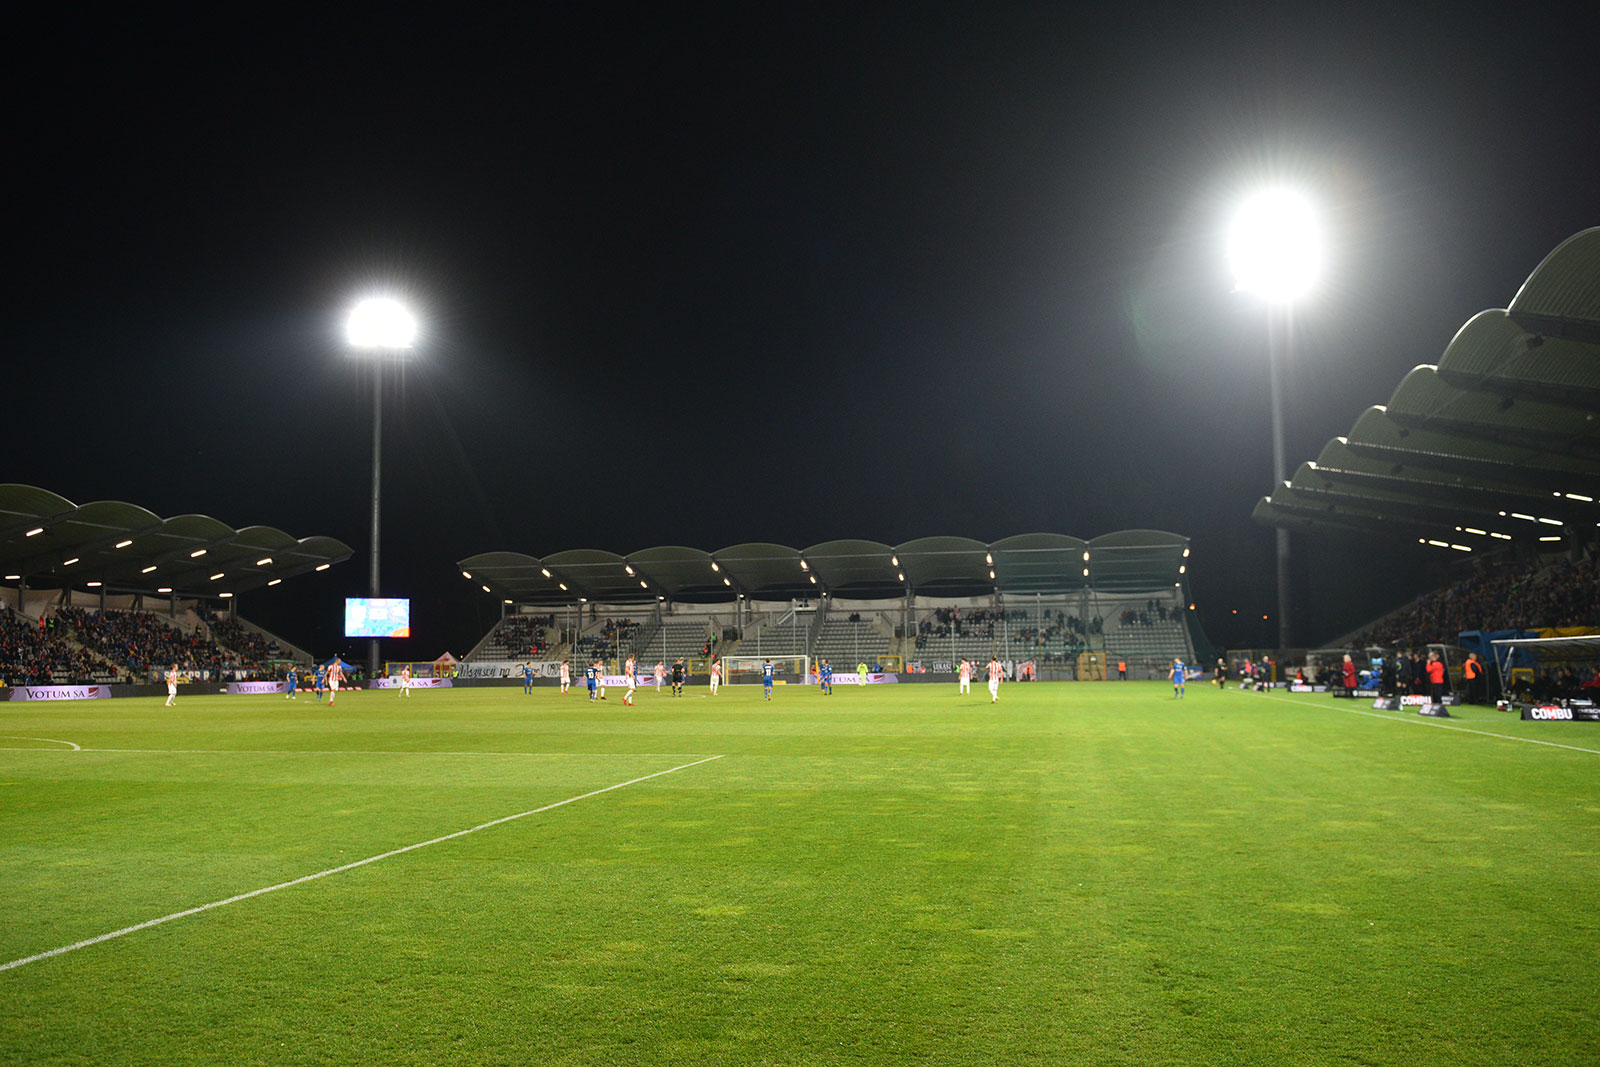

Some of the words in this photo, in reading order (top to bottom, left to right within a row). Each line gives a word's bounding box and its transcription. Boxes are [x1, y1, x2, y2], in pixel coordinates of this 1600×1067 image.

[588, 671, 594, 679] 10
[236, 683, 265, 693] VOTUM
[26, 688, 70, 699] VOTUM
[73, 690, 85, 698] SA
[1401, 695, 1432, 705] COMBU
[1531, 708, 1573, 719] COMBU
